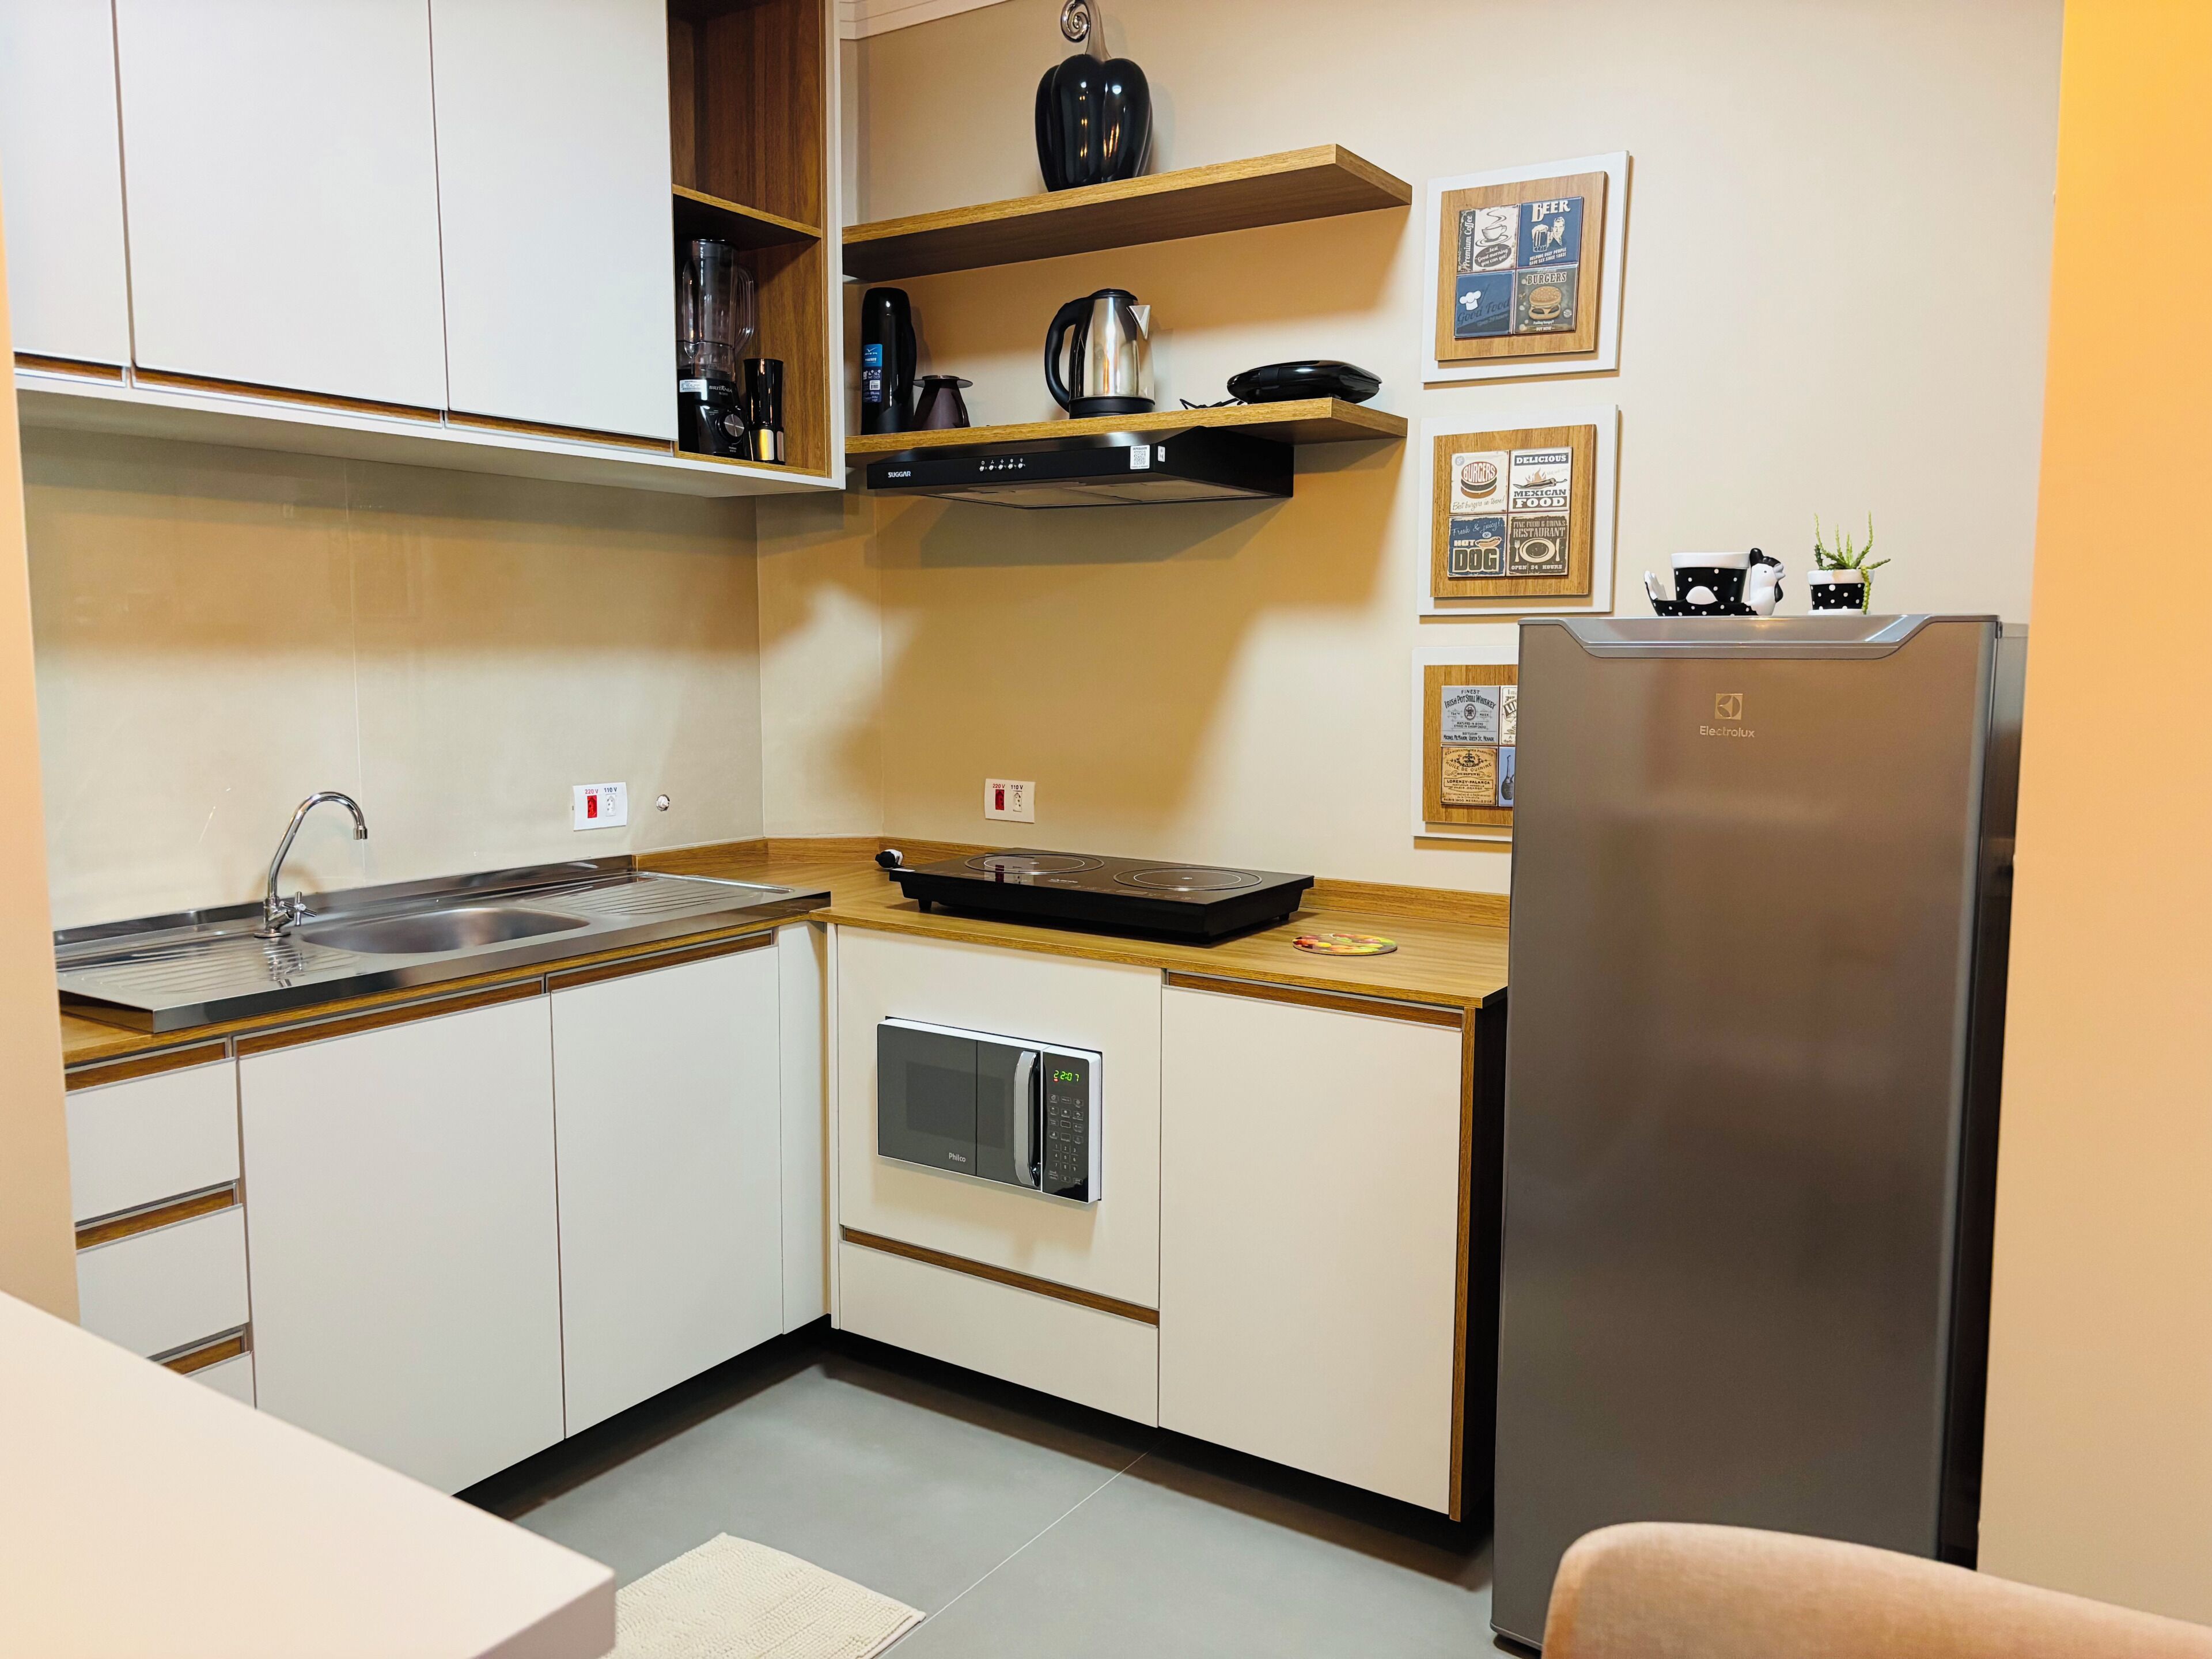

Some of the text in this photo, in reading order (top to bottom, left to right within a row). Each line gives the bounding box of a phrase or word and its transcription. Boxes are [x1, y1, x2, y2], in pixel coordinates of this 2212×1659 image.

[1531, 200, 1571, 222] BEER
[1463, 215, 1474, 266] Premium Coffee
[1527, 272, 1567, 285] BURGERS
[1457, 298, 1510, 327] Good Food
[1516, 455, 1566, 464] DELICIOUS
[1463, 462, 1495, 483] BURGERS
[1514, 489, 1566, 497] MEXICAN
[1453, 501, 1464, 510] Best
[1465, 501, 1482, 512] burgers
[1516, 497, 1565, 507] FOOD
[1451, 525, 1470, 536] Fresh
[1473, 521, 1480, 532] &
[1513, 527, 1566, 538] RESTAURANT
[1452, 547, 1499, 572] DOG
[1444, 694, 1496, 709] IRISH POT STILL WHISKEY
[1700, 725, 1755, 738] Electrolux
[1446, 761, 1460, 770] HUILE
[1470, 763, 1492, 772] QUININE
[1054, 1070, 1080, 1082] 22:07
[949, 1152, 966, 1162] Philco
